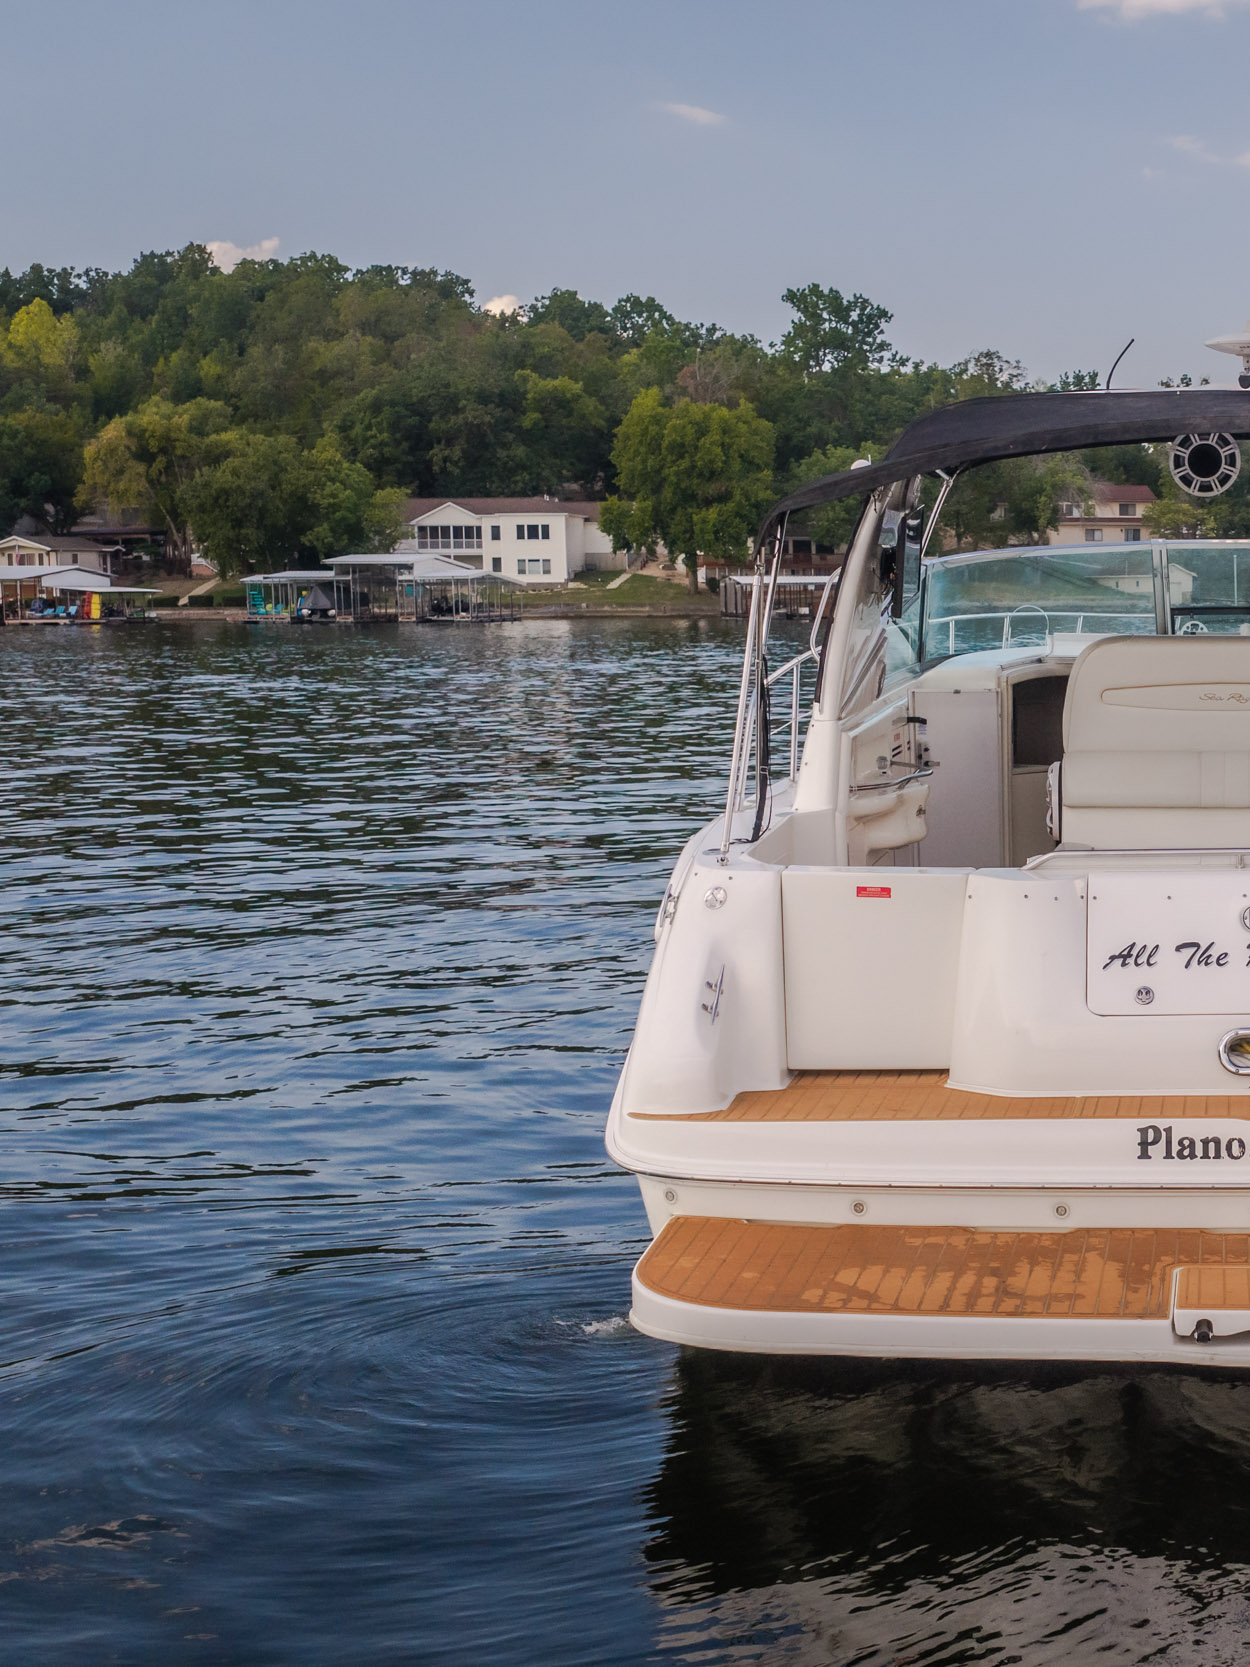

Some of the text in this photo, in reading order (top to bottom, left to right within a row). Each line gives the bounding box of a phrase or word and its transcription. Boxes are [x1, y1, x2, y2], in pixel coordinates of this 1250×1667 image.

[1199, 692, 1224, 702] Sea
[1102, 941, 1160, 970] All
[1174, 941, 1229, 969] The
